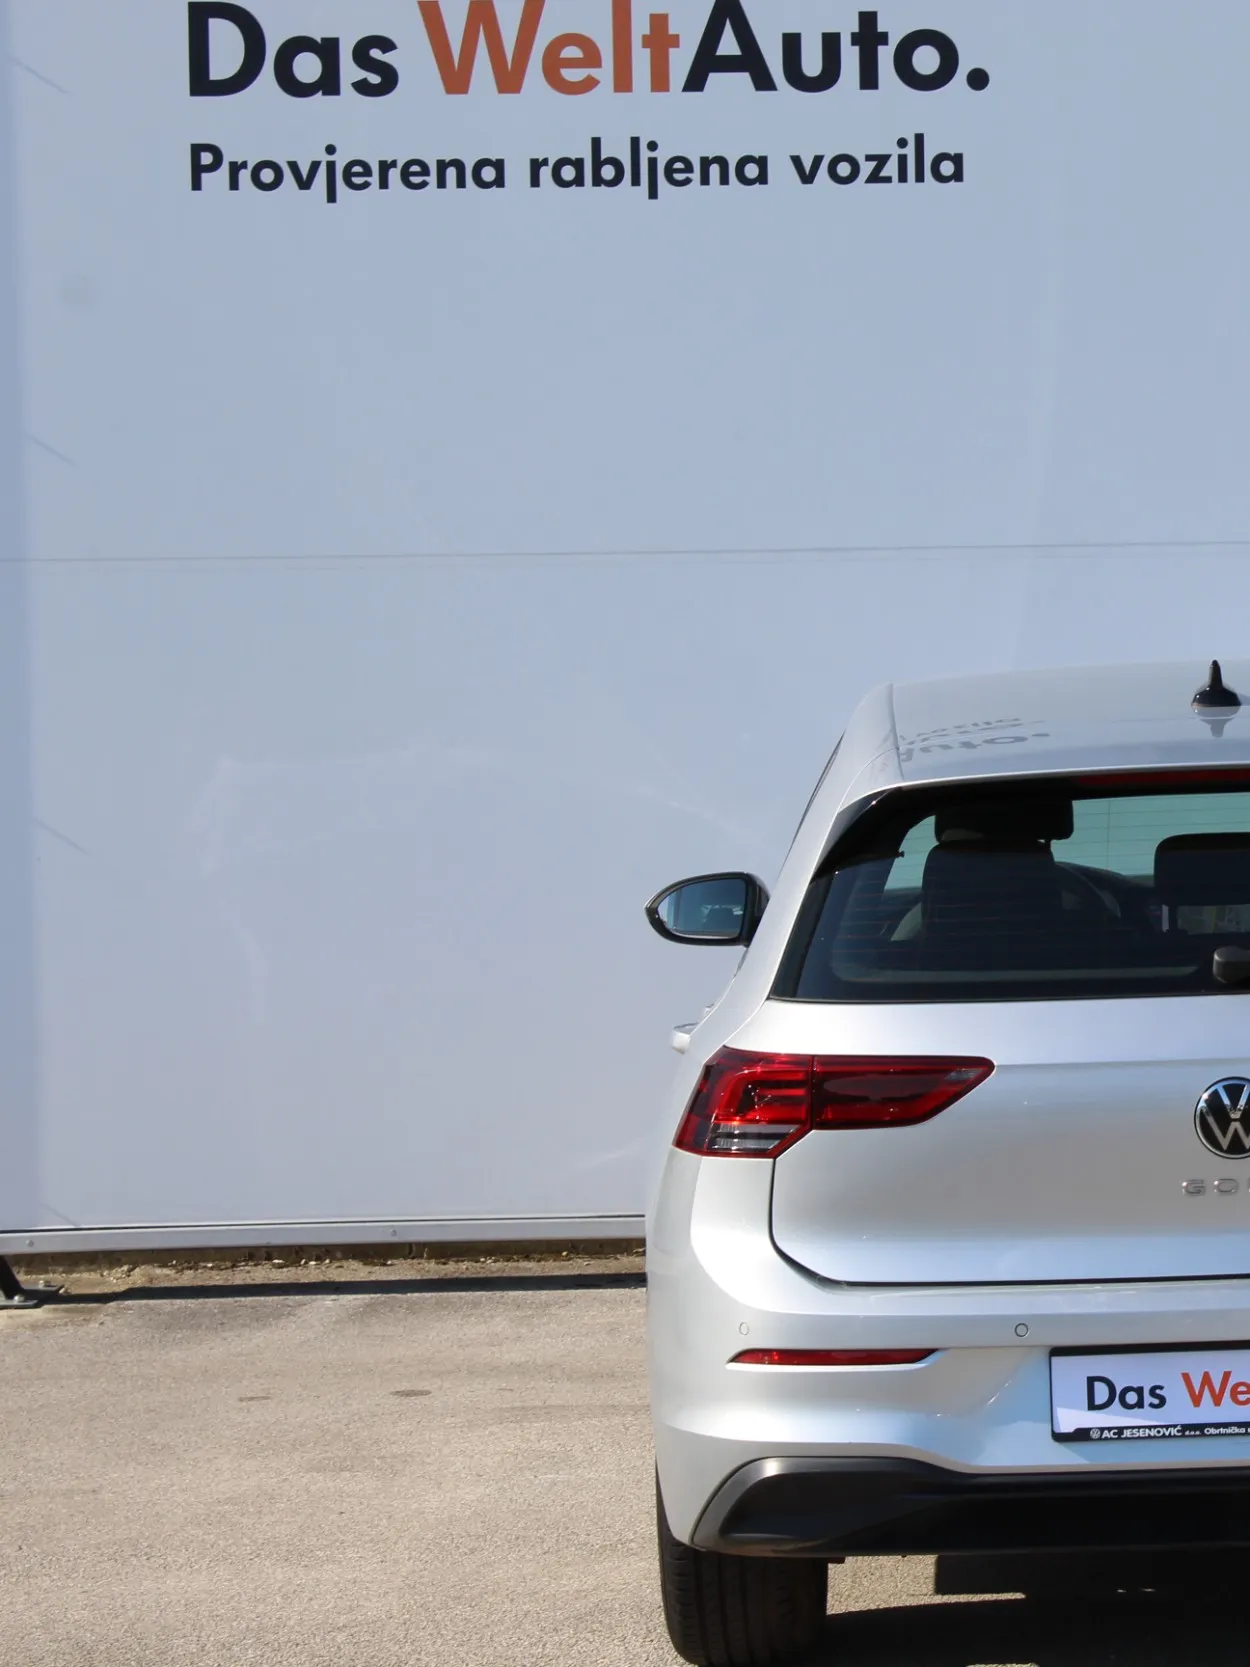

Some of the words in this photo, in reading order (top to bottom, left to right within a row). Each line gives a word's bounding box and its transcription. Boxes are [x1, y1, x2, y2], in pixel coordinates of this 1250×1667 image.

[187, 0, 399, 99] Das
[417, 0, 990, 96] WeltAuto.
[190, 143, 506, 204] Provjerena
[529, 136, 769, 200] rabljena
[789, 132, 964, 186] vozila
[1086, 1375, 1167, 1412] Das
[1101, 1429, 1119, 1439] AC
[1120, 1425, 1182, 1438] JESENOVIĆ
[1203, 1425, 1246, 1435] Obrtnička
